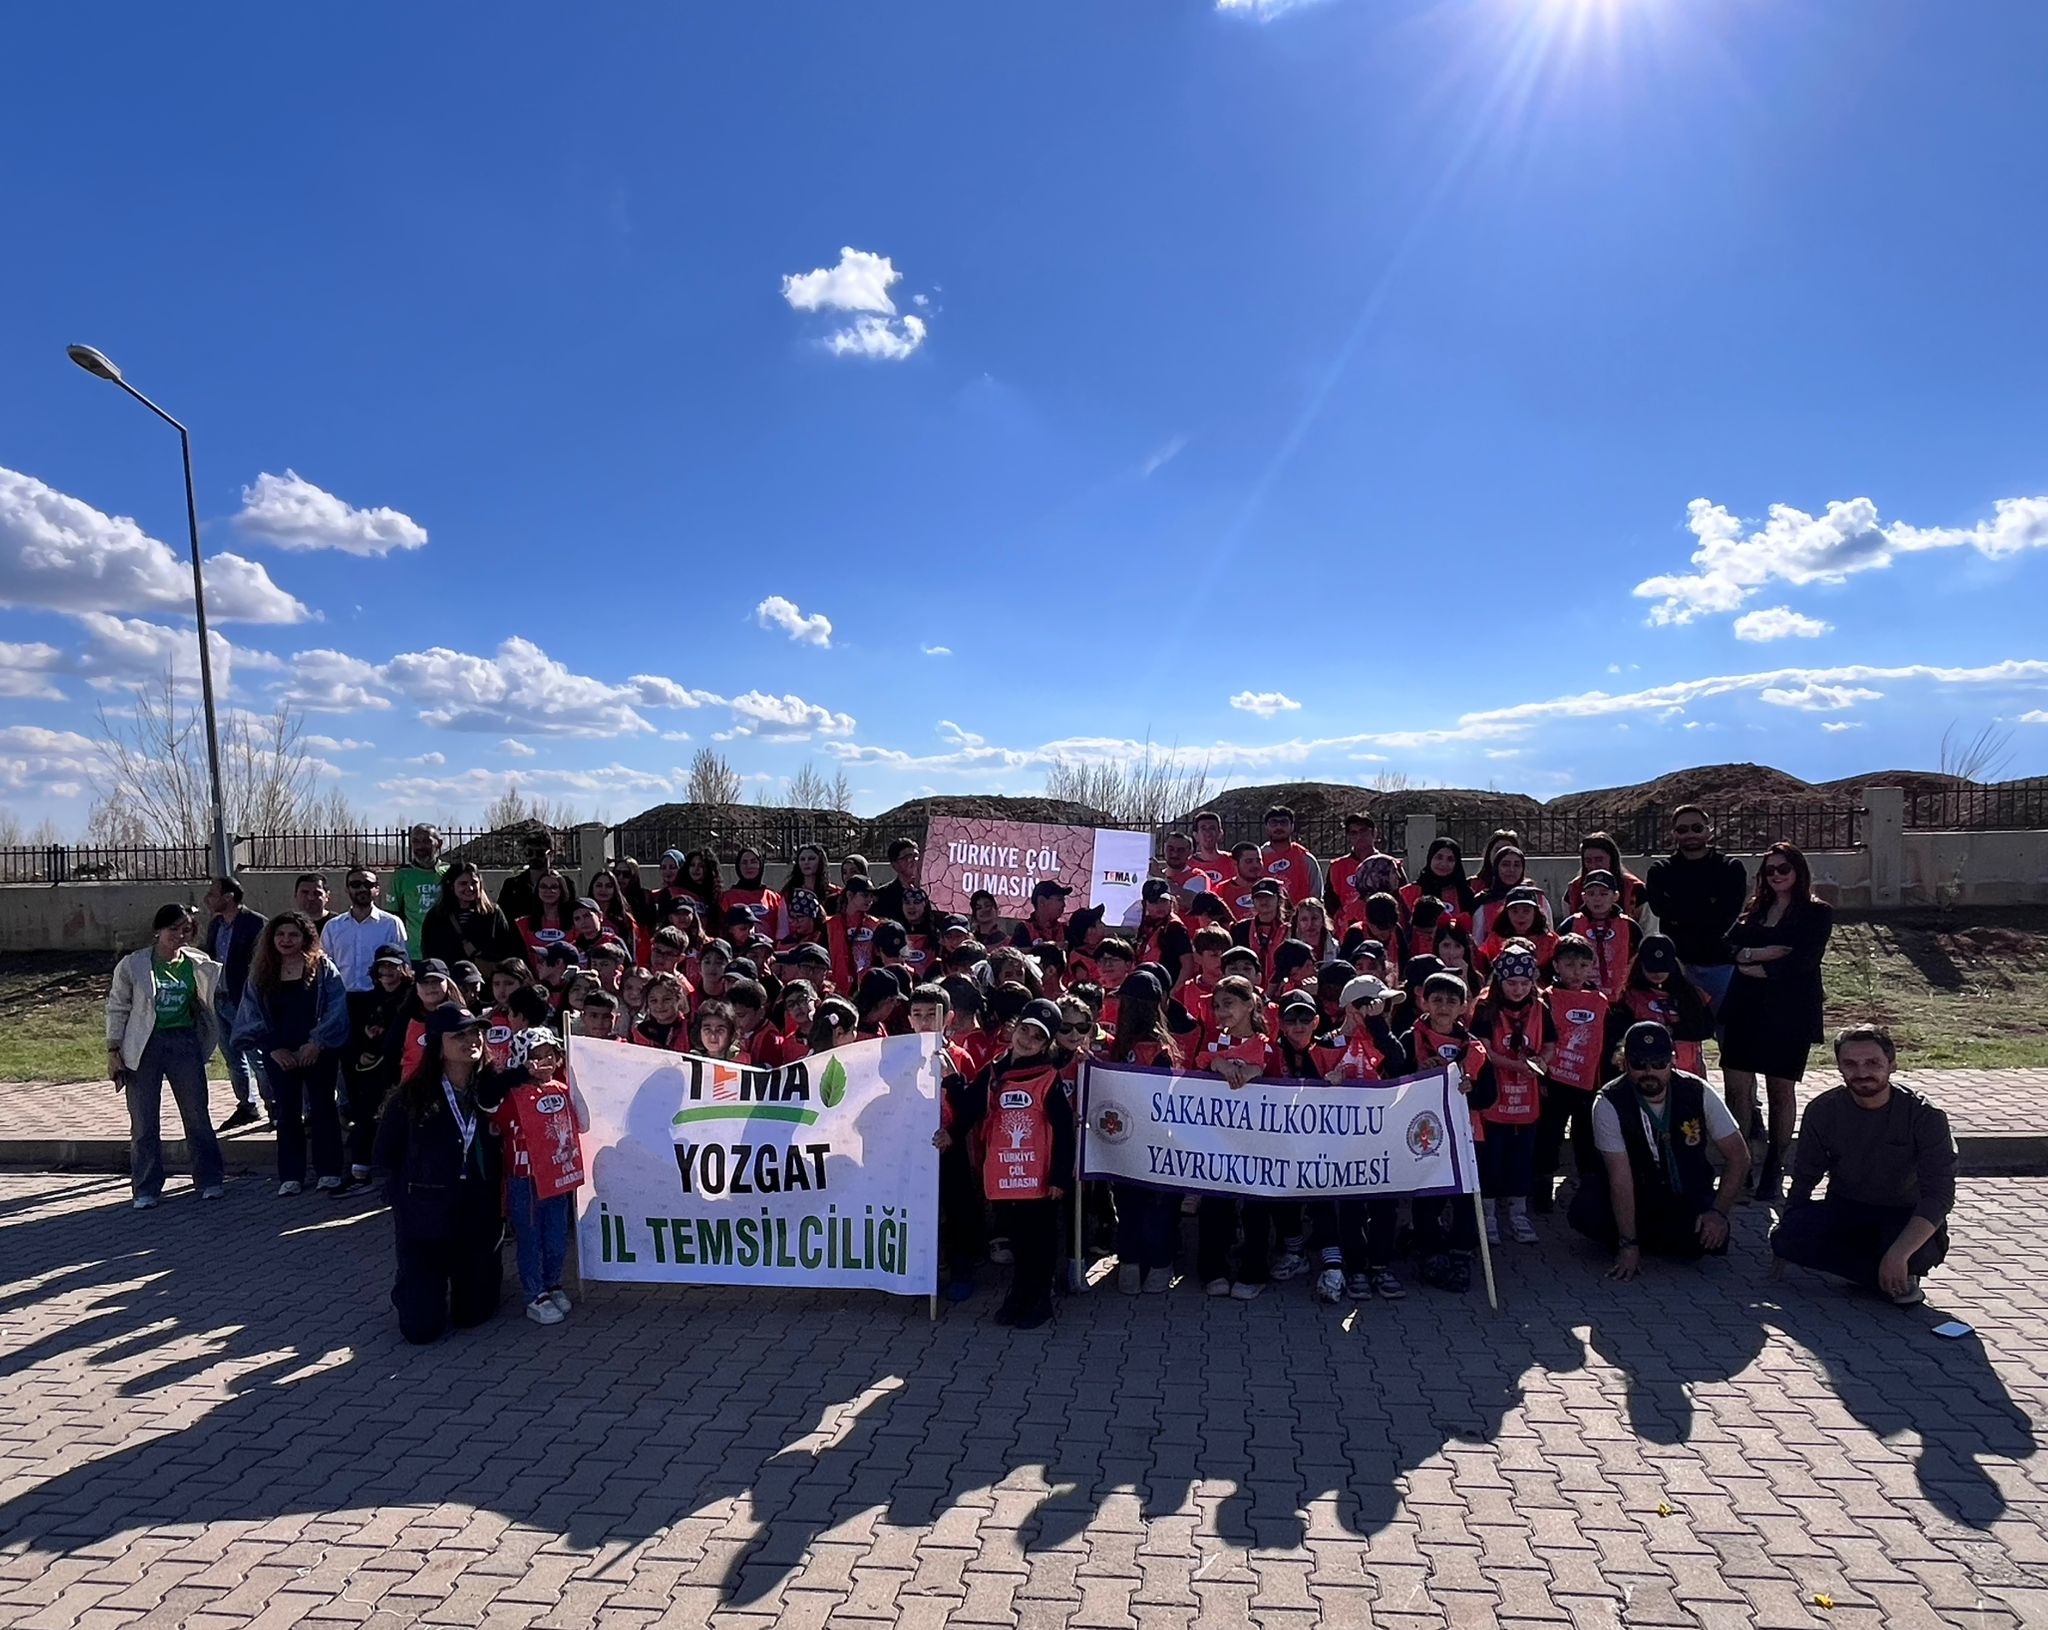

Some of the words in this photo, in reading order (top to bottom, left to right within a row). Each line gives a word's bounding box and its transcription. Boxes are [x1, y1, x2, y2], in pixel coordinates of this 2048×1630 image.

[947, 839, 1020, 869] TÜRKİYE
[1025, 845, 1061, 876] ÇÖL
[1103, 871, 1131, 883] TEMA
[683, 1055, 810, 1102] TEMA
[1150, 1092, 1254, 1131] SAKARYA
[1258, 1095, 1385, 1136] İLKOKULU
[674, 1143, 831, 1194] YOZGAT
[998, 1150, 1036, 1162] TÜRKİYE
[1009, 1164, 1026, 1176] ÇÖL
[1147, 1145, 1290, 1188] YAVRUKURT
[1296, 1151, 1391, 1189] KÜMESİ
[998, 1177, 1038, 1189] OLMASIN
[600, 1202, 636, 1263] İL
[646, 1204, 907, 1276] TEMSİLCİLİĞİ
